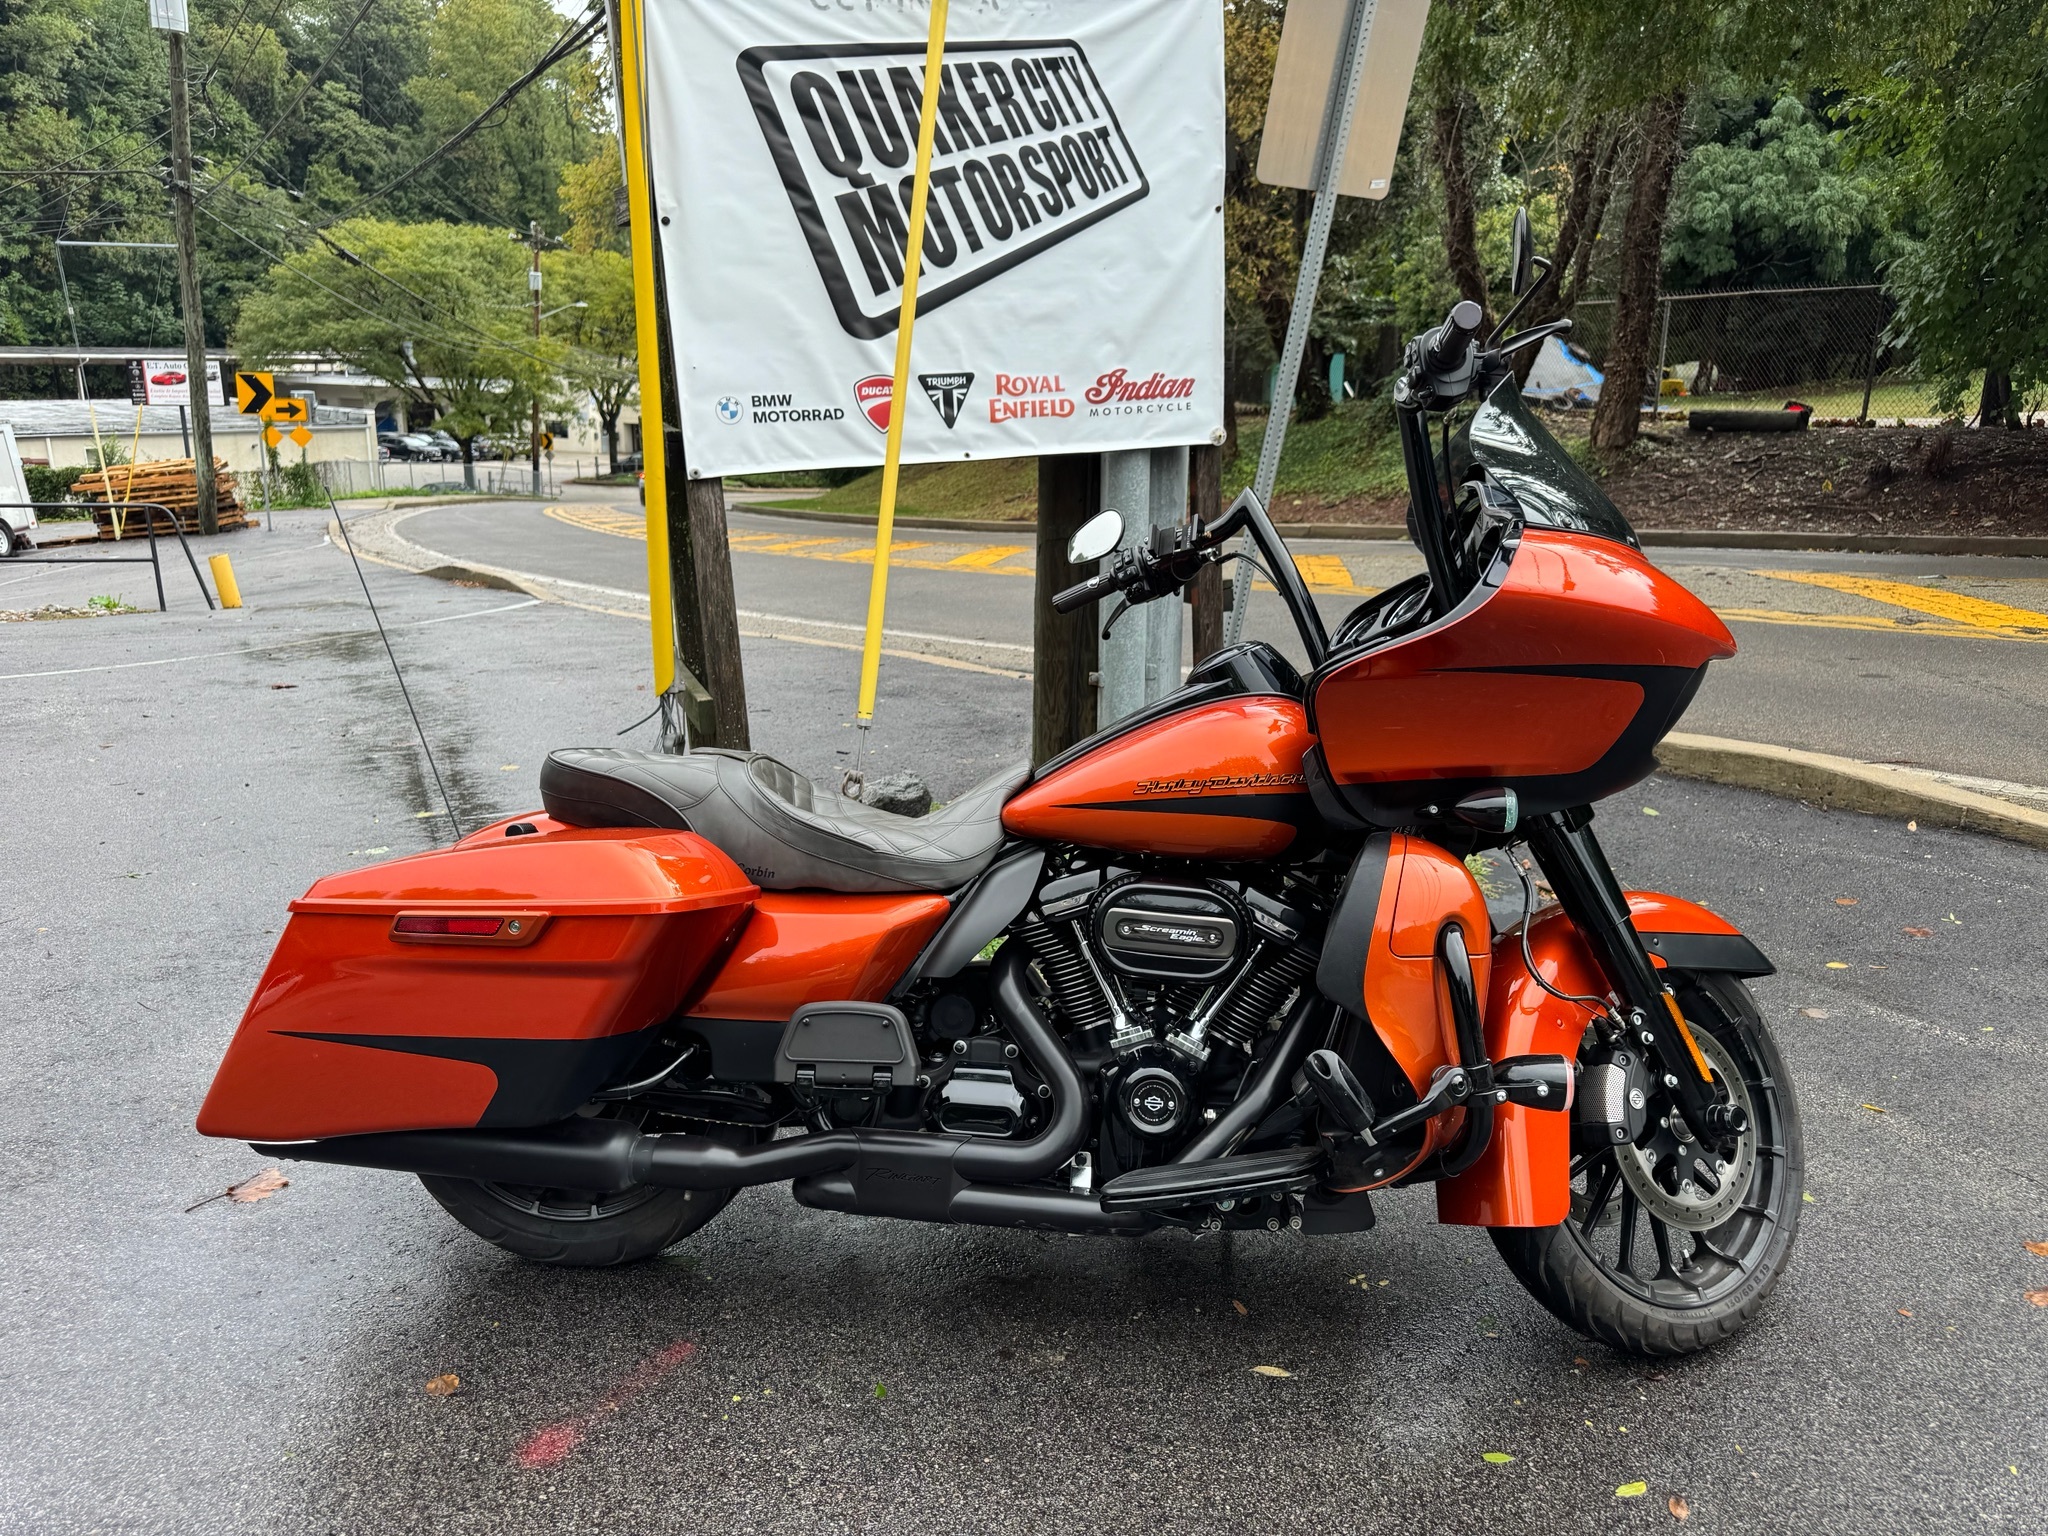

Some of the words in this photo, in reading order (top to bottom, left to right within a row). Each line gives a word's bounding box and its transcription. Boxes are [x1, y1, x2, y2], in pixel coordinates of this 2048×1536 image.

[791, 61, 1034, 189] QUAKER
[1012, 56, 1099, 131] CITY
[835, 126, 1128, 297] MOTORSPORT
[926, 376, 967, 386] TRIUMPH
[995, 374, 1066, 396] ROYAL
[1084, 368, 1196, 404] Indian
[861, 386, 893, 396] DUCAT
[751, 394, 793, 407] BMW
[753, 408, 845, 423] MOTORRAD
[988, 398, 1075, 424] ENFIELD
[1089, 402, 1192, 417] MOTORCYCLE
[1169, 933, 1206, 943] Eagle
